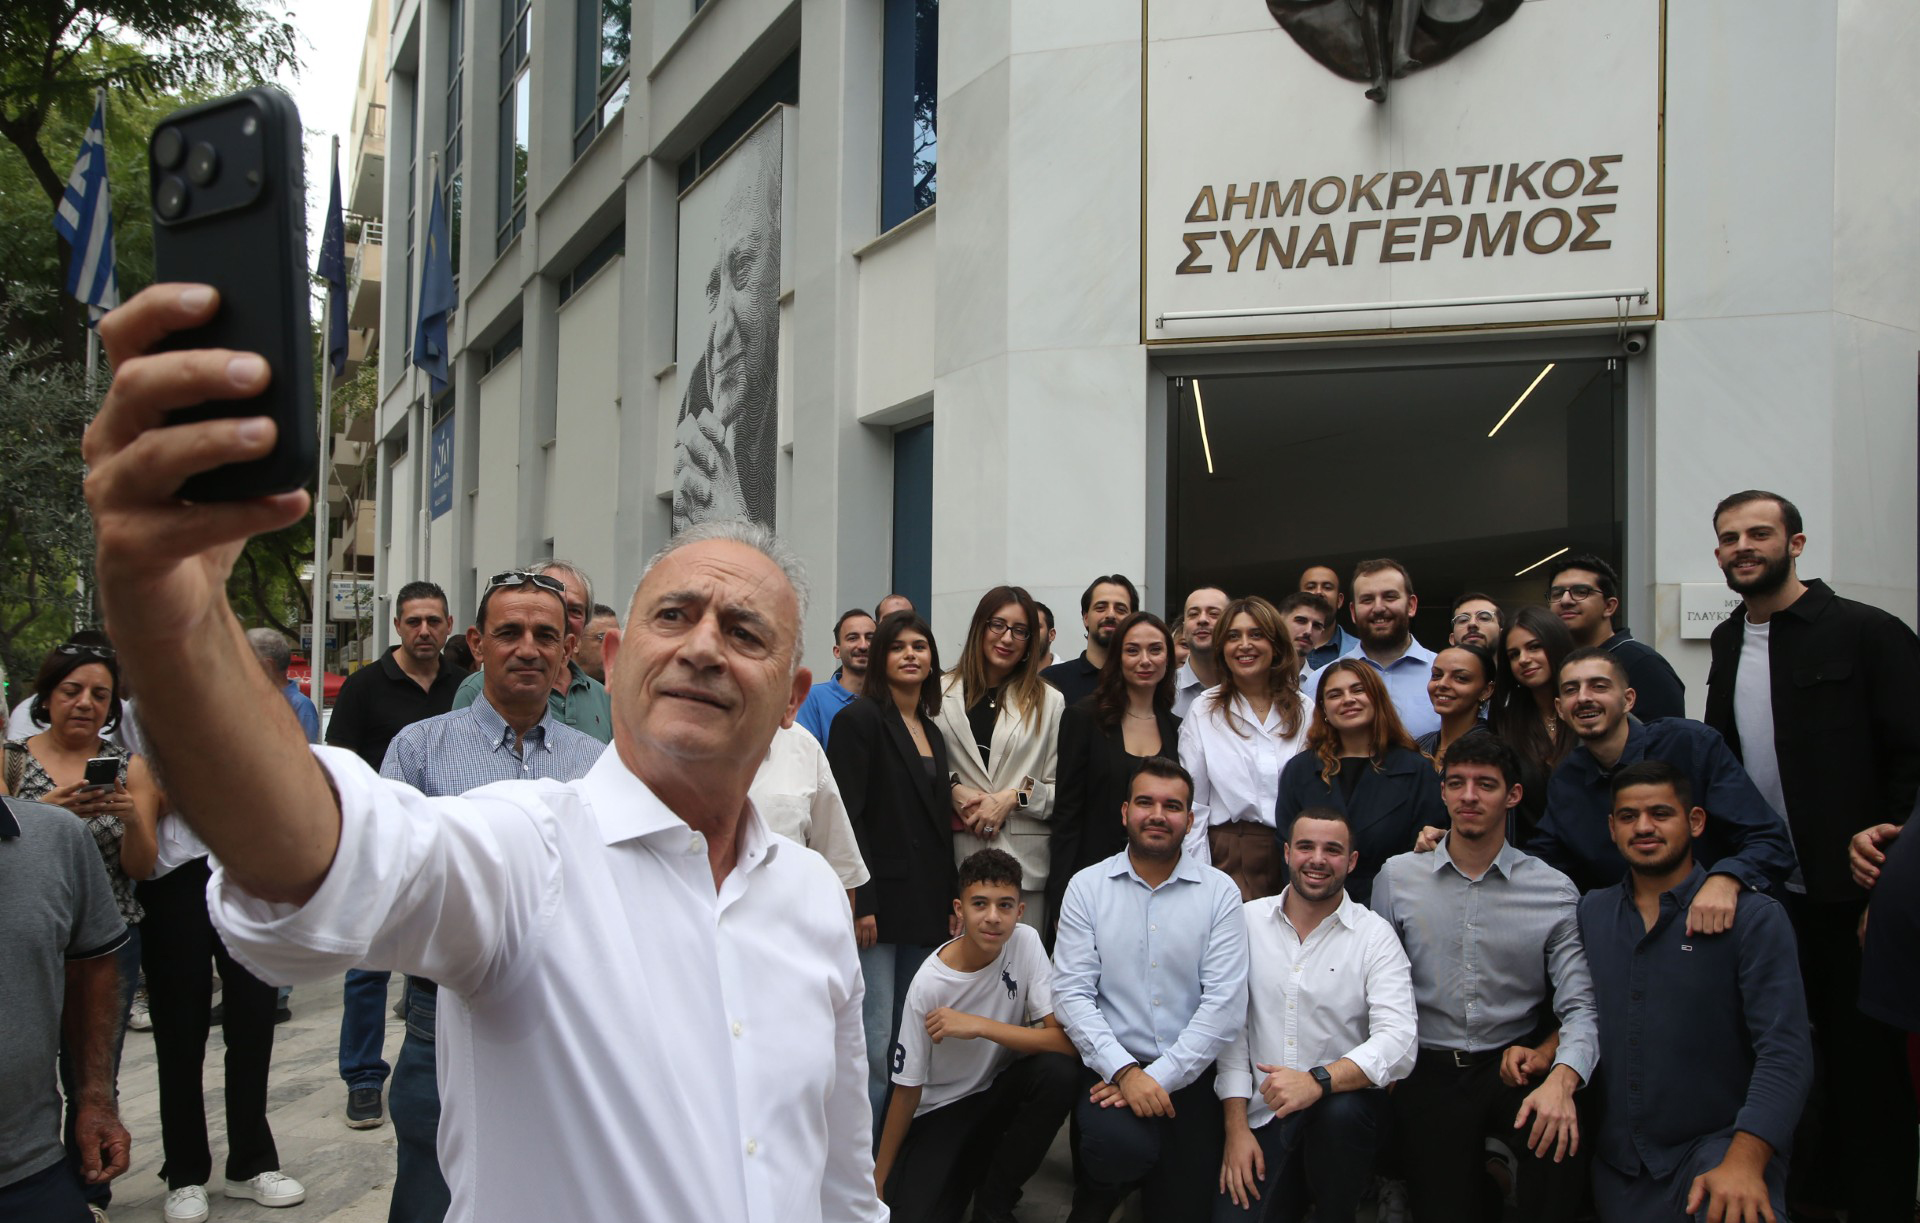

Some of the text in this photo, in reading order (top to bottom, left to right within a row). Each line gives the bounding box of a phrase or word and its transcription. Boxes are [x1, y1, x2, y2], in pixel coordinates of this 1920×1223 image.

[1185, 154, 1623, 223] ΔΗΜΟΚΡΑΤΙΚΟΣ
[1175, 203, 1617, 275] ΣΥΝΑΓΕΡΜΟΣ
[892, 1043, 906, 1074] 3
